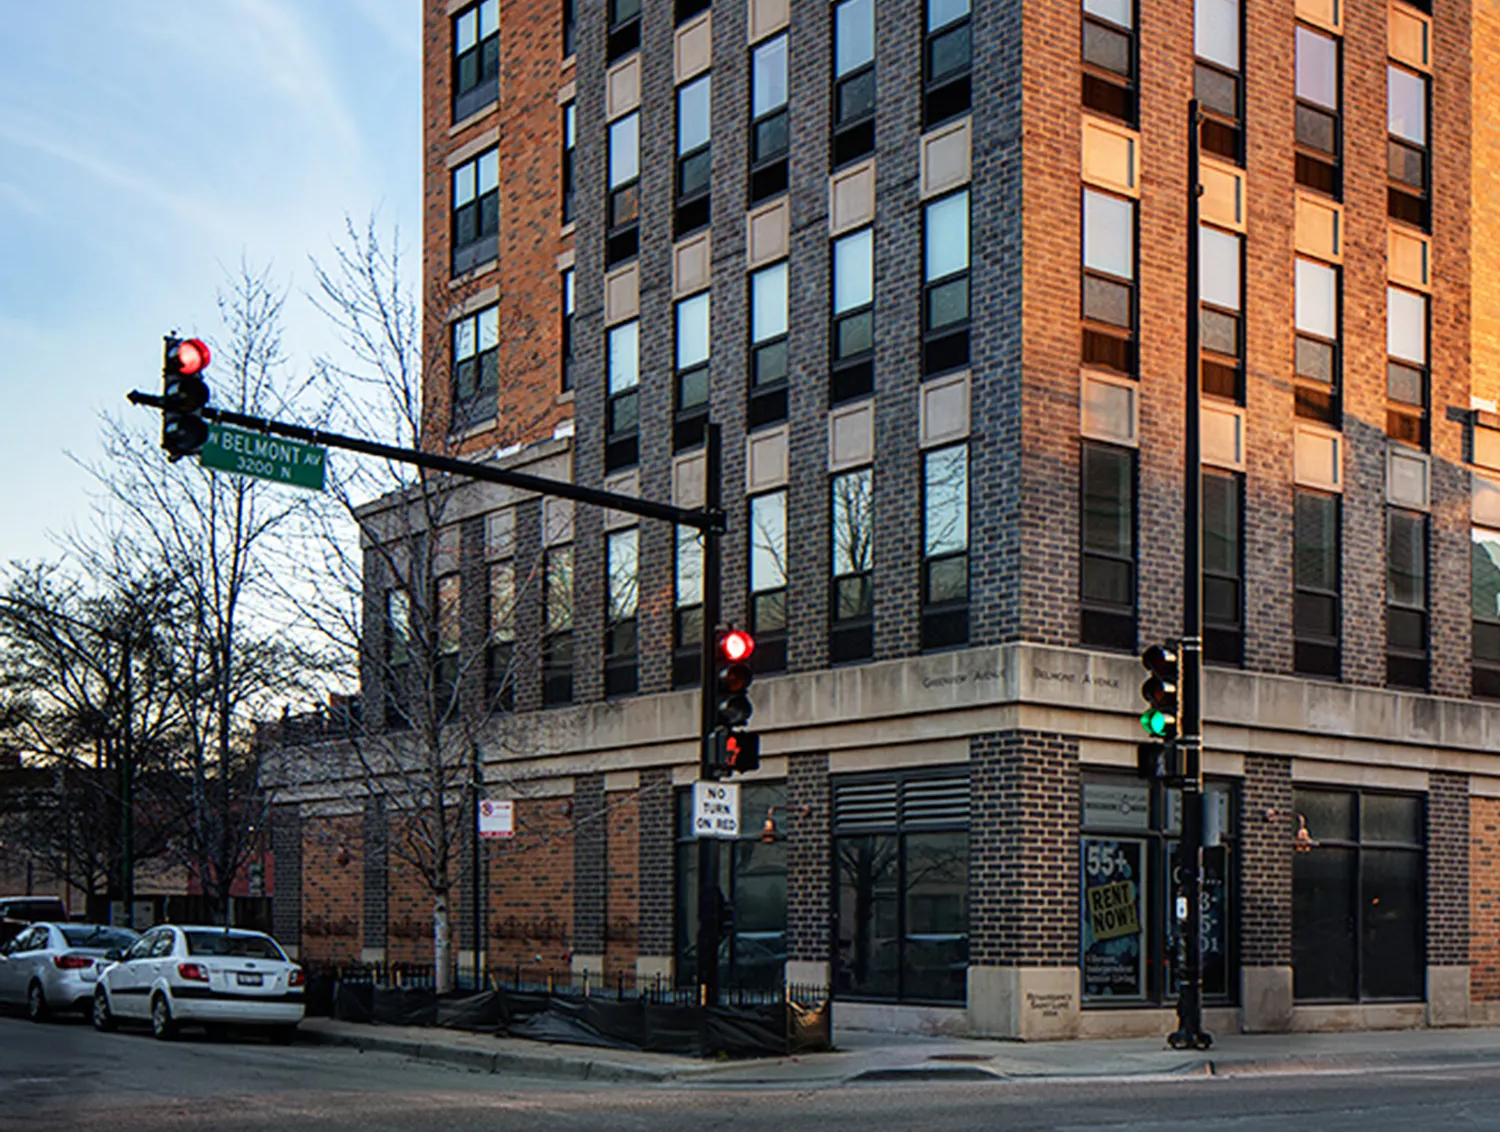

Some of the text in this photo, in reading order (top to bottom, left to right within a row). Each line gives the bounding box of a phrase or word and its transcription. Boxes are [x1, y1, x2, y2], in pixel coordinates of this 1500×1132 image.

[221, 431, 301, 465] BELMONT
[236, 455, 292, 479] 3200 N
[707, 787, 726, 800] NO
[703, 801, 731, 815] TURN
[696, 816, 737, 831] ON RED
[1087, 844, 1128, 877] 55+
[1092, 883, 1130, 912] RENT
[1092, 904, 1136, 934] NOW!
